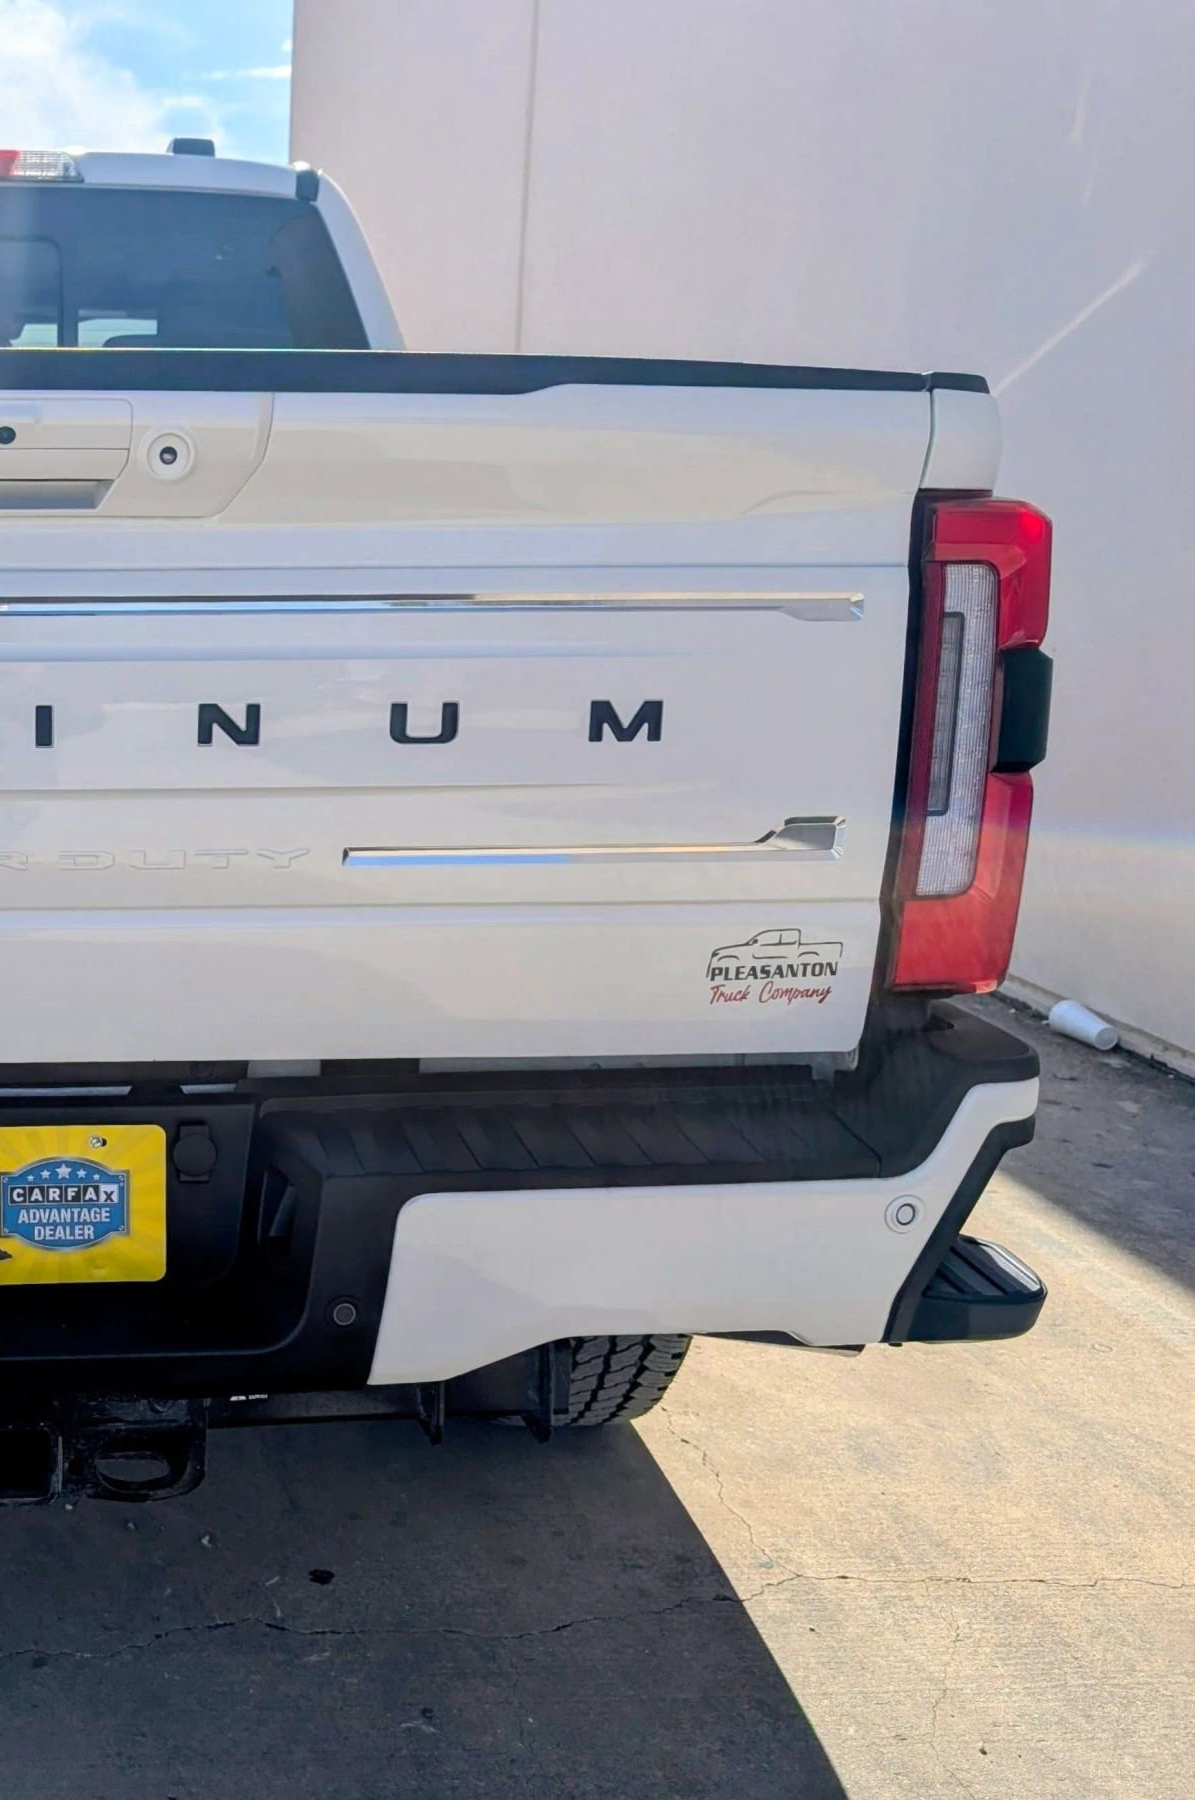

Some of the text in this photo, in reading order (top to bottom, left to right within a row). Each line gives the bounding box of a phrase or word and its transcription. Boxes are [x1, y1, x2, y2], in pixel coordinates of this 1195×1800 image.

[57, 847, 311, 871] DUTY
[710, 961, 839, 981] PLEASANTON
[709, 980, 832, 1005] Truck Company
[11, 1186, 117, 1203] CARFAX
[17, 1207, 111, 1224] ADVANTAGE
[34, 1225, 95, 1241] DEALER
